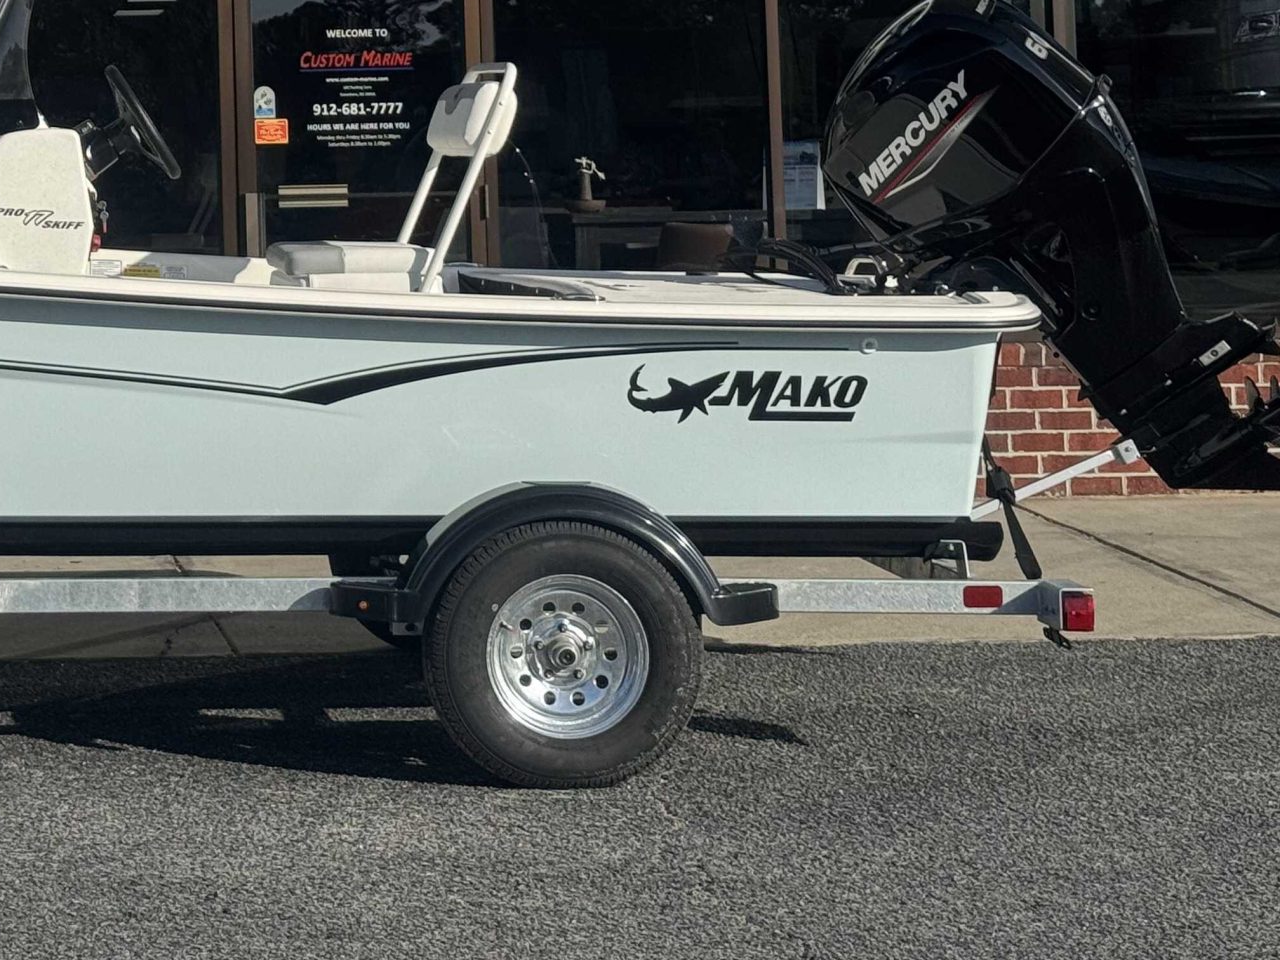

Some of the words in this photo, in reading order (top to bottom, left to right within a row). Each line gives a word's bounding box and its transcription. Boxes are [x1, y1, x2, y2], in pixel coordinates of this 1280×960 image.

[325, 28, 373, 38] WELCOME
[374, 28, 388, 37] TO
[299, 51, 356, 68] CUSTOM
[360, 49, 413, 67] MARINE
[312, 102, 403, 116] 912-681-7777
[307, 123, 331, 131] HOURS
[332, 123, 344, 131] WE
[360, 122, 378, 130] HERE
[379, 122, 394, 130] FOR
[857, 68, 968, 197] MERCURY
[41, 220, 85, 230] SKIFF
[708, 370, 869, 422] MAKO
